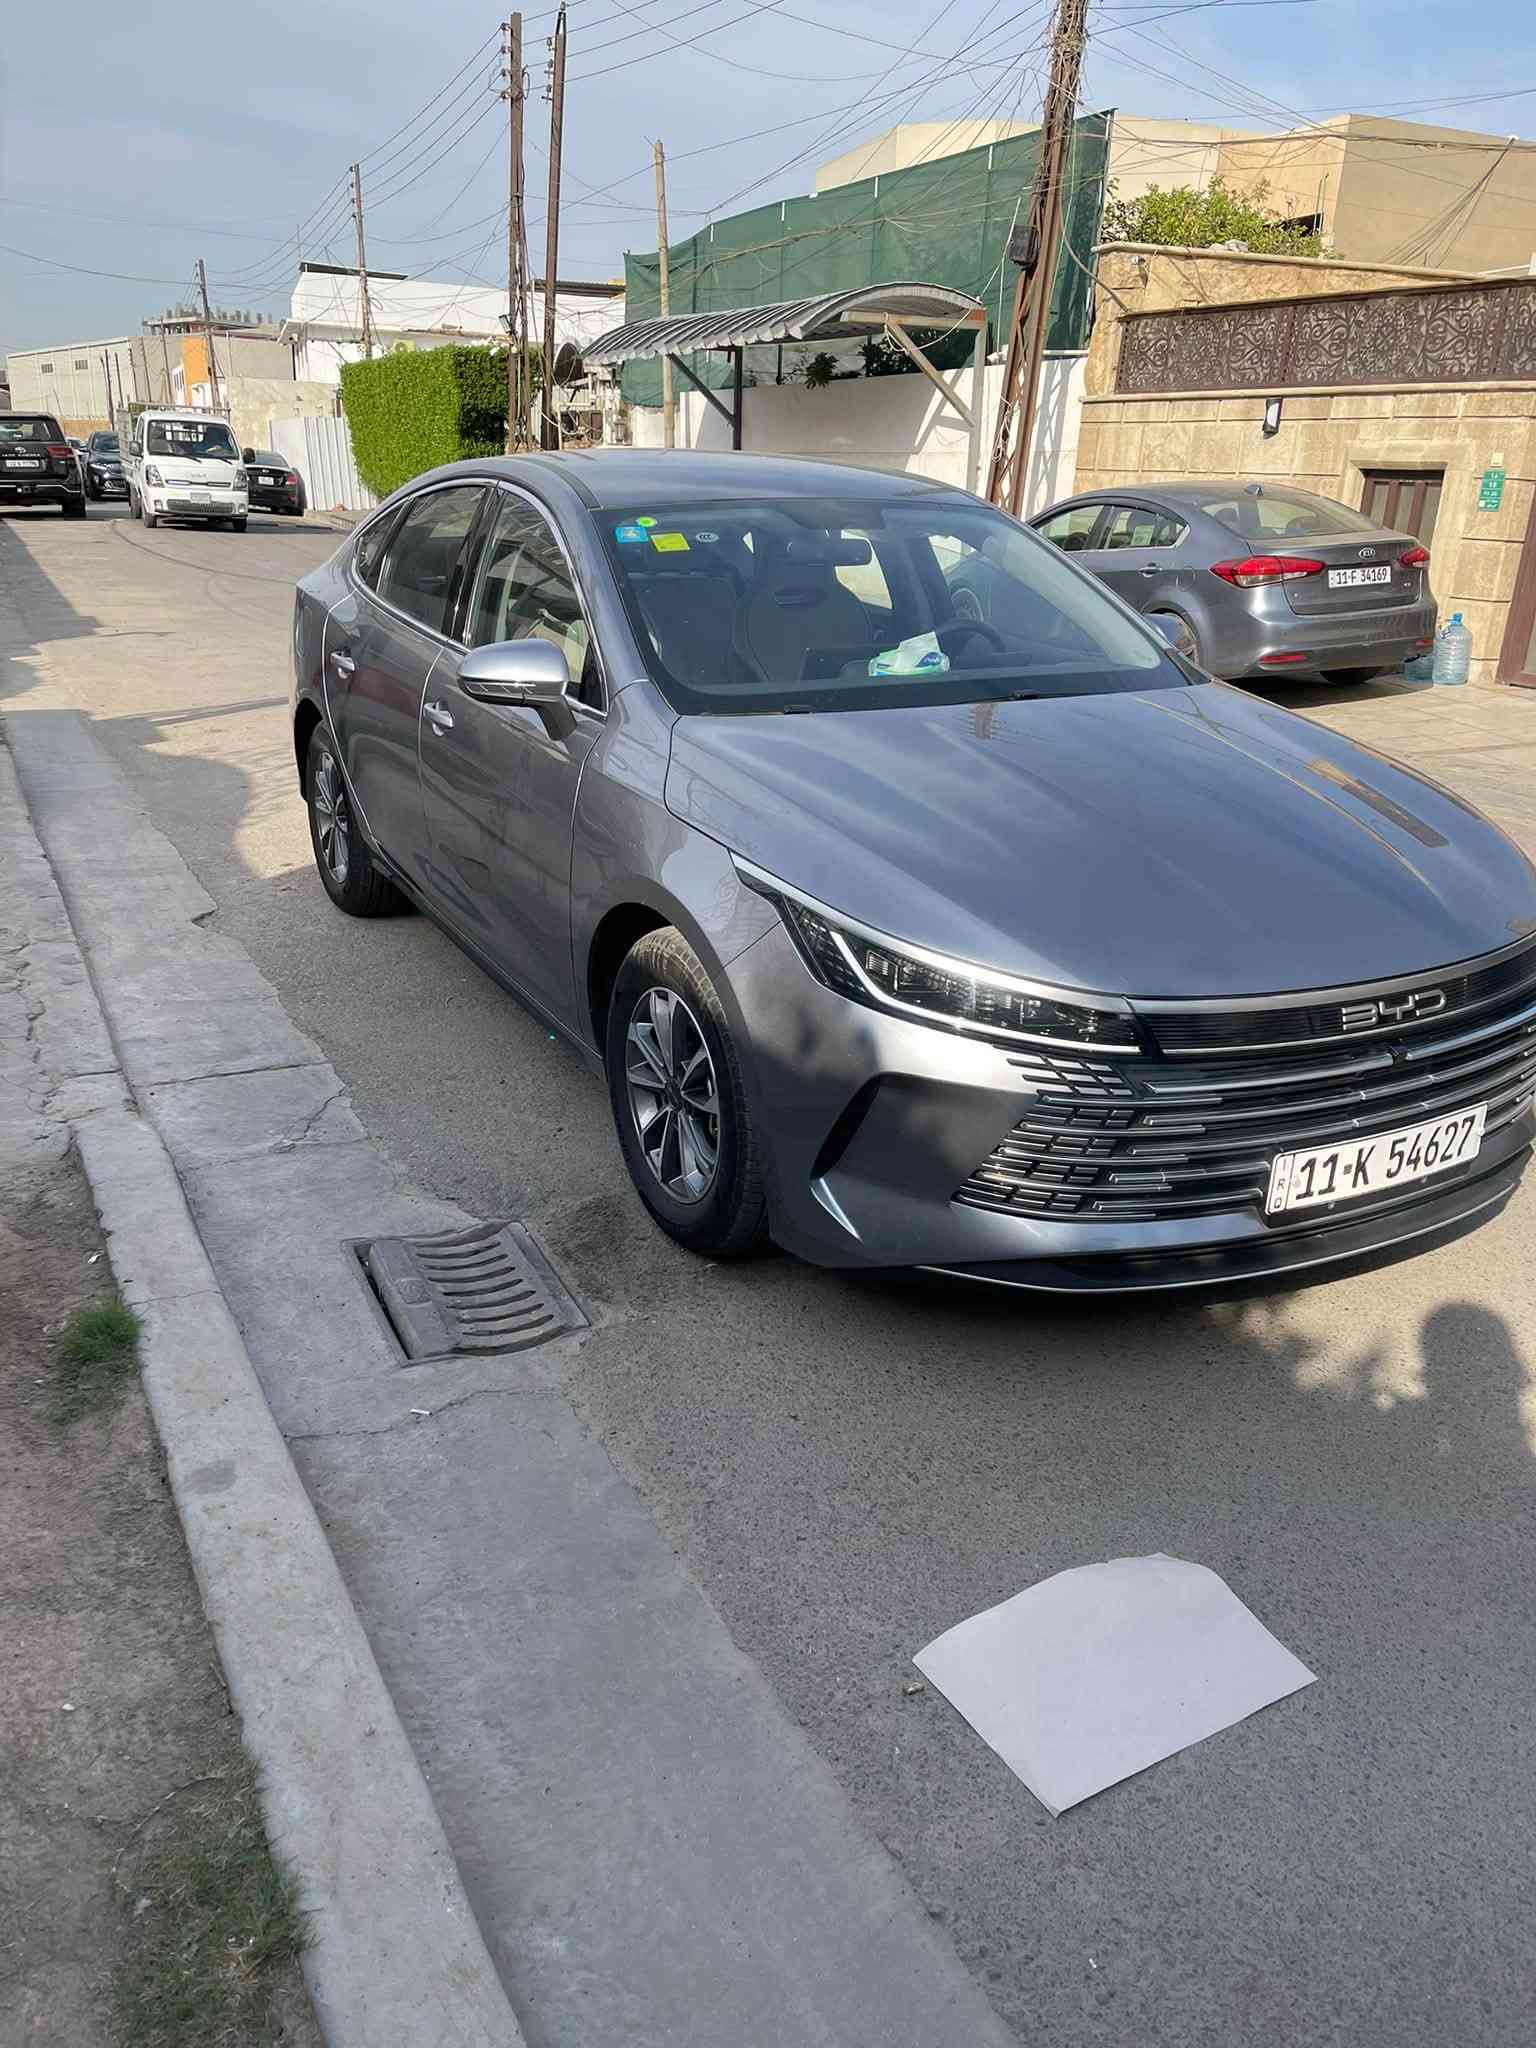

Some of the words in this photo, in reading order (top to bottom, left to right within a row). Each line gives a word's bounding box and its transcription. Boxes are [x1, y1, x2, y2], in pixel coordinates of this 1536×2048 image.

[1361, 567, 1387, 583] 34169
[1341, 989, 1446, 1031] BYD
[1295, 1144, 1377, 1200] 11-K
[1386, 1114, 1477, 1179] 54627
